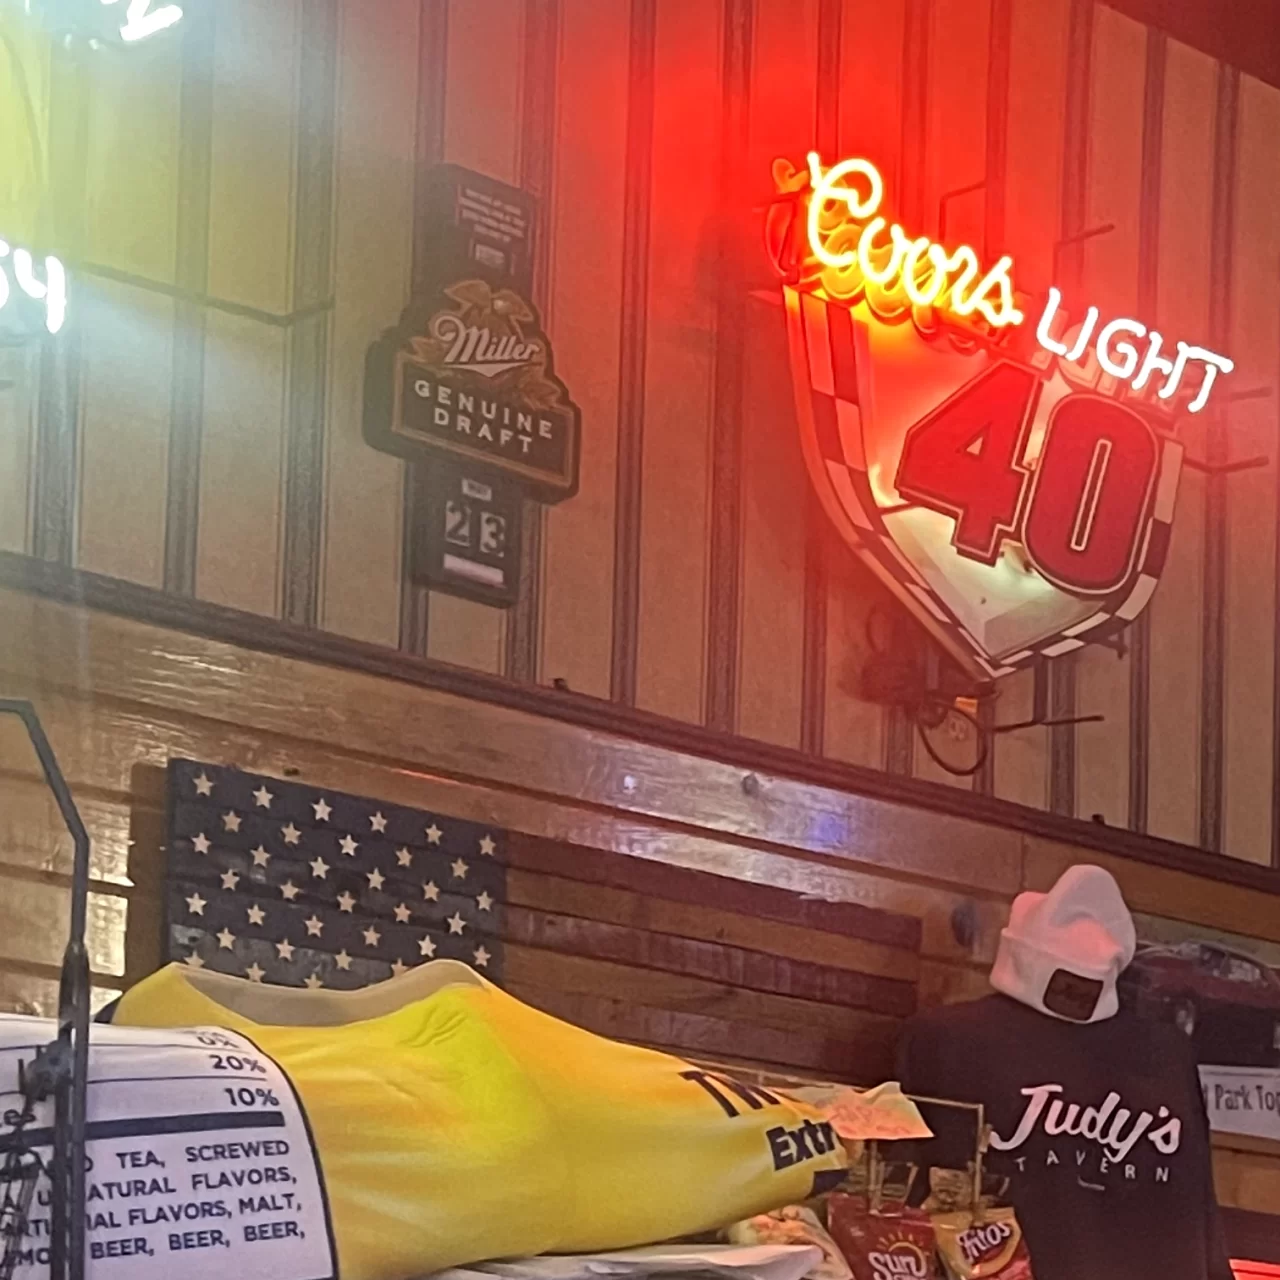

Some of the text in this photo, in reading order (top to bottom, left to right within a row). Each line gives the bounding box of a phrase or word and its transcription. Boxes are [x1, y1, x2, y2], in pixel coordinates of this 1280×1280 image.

[807, 151, 1234, 413] Coors LIGHT
[431, 315, 542, 363] Miller
[414, 379, 553, 440] GENUINE
[433, 407, 533, 453] DRAFT
[892, 359, 1160, 595] 40
[208, 1054, 268, 1075] 20%
[224, 1087, 280, 1107] 10%
[1213, 1083, 1253, 1111] Park
[990, 1083, 1182, 1164] Judy's
[115, 1140, 290, 1169] TEA, SCREWED
[1014, 1149, 1169, 1184] TAVERN
[191, 1167, 298, 1191] FLAVORS,
[128, 1203, 232, 1226] FLAVORS,
[239, 1193, 302, 1213] MALT,
[90, 1220, 306, 1260] BEER, BEER, BEER,
[956, 1222, 1011, 1264] Fritos
